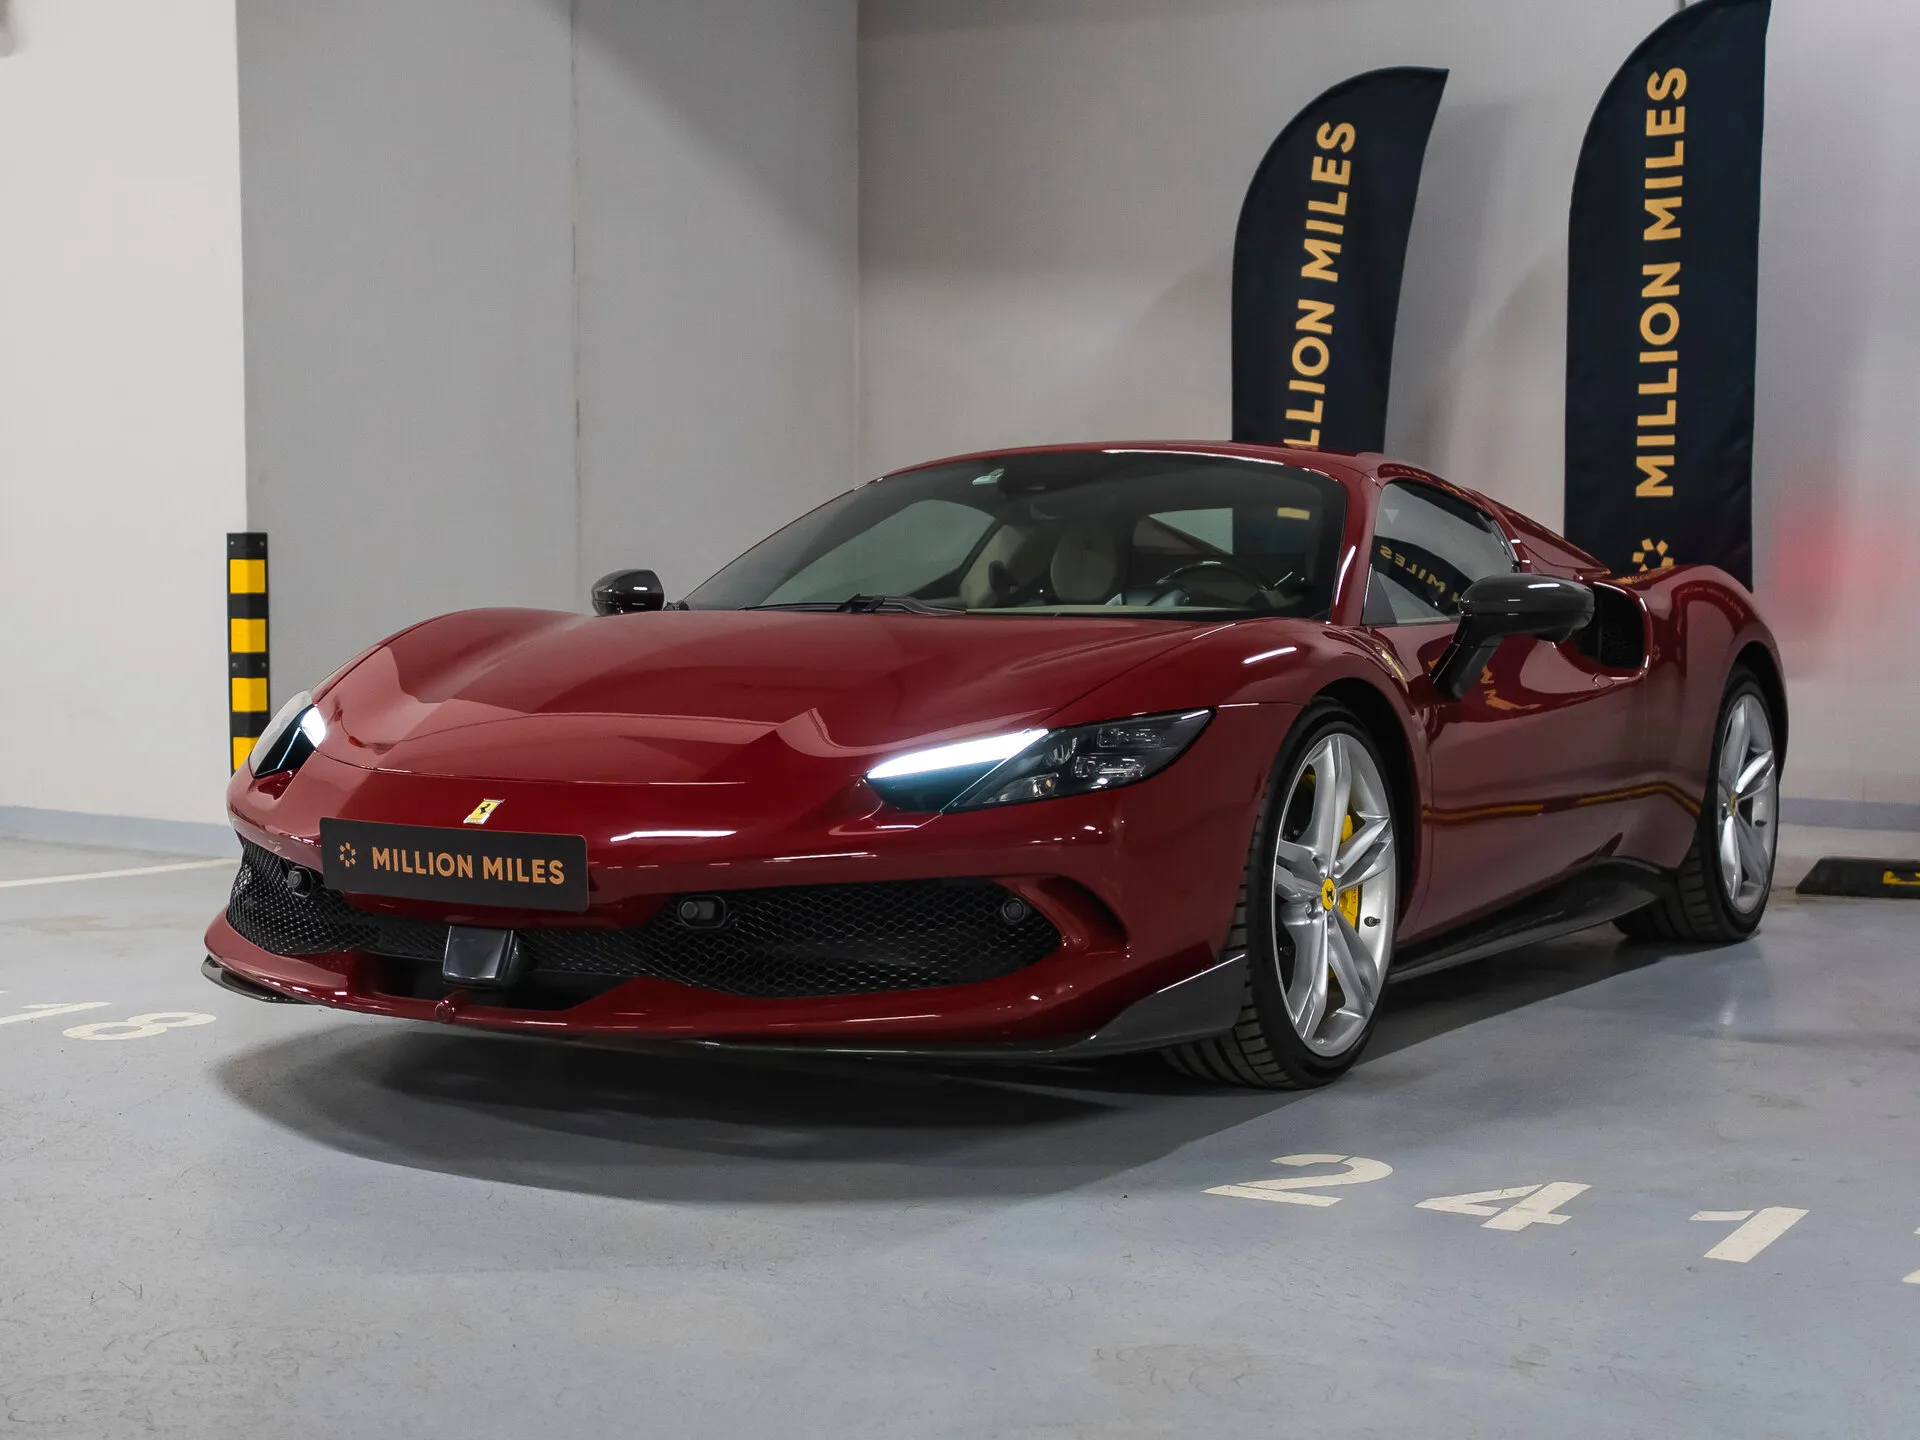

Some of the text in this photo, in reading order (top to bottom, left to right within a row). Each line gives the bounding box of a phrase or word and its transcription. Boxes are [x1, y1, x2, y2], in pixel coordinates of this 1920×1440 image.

[1283, 121, 1356, 450] LLION MILES
[1636, 67, 1688, 497] MILLION MILES
[372, 847, 565, 886] MILLION MILES
